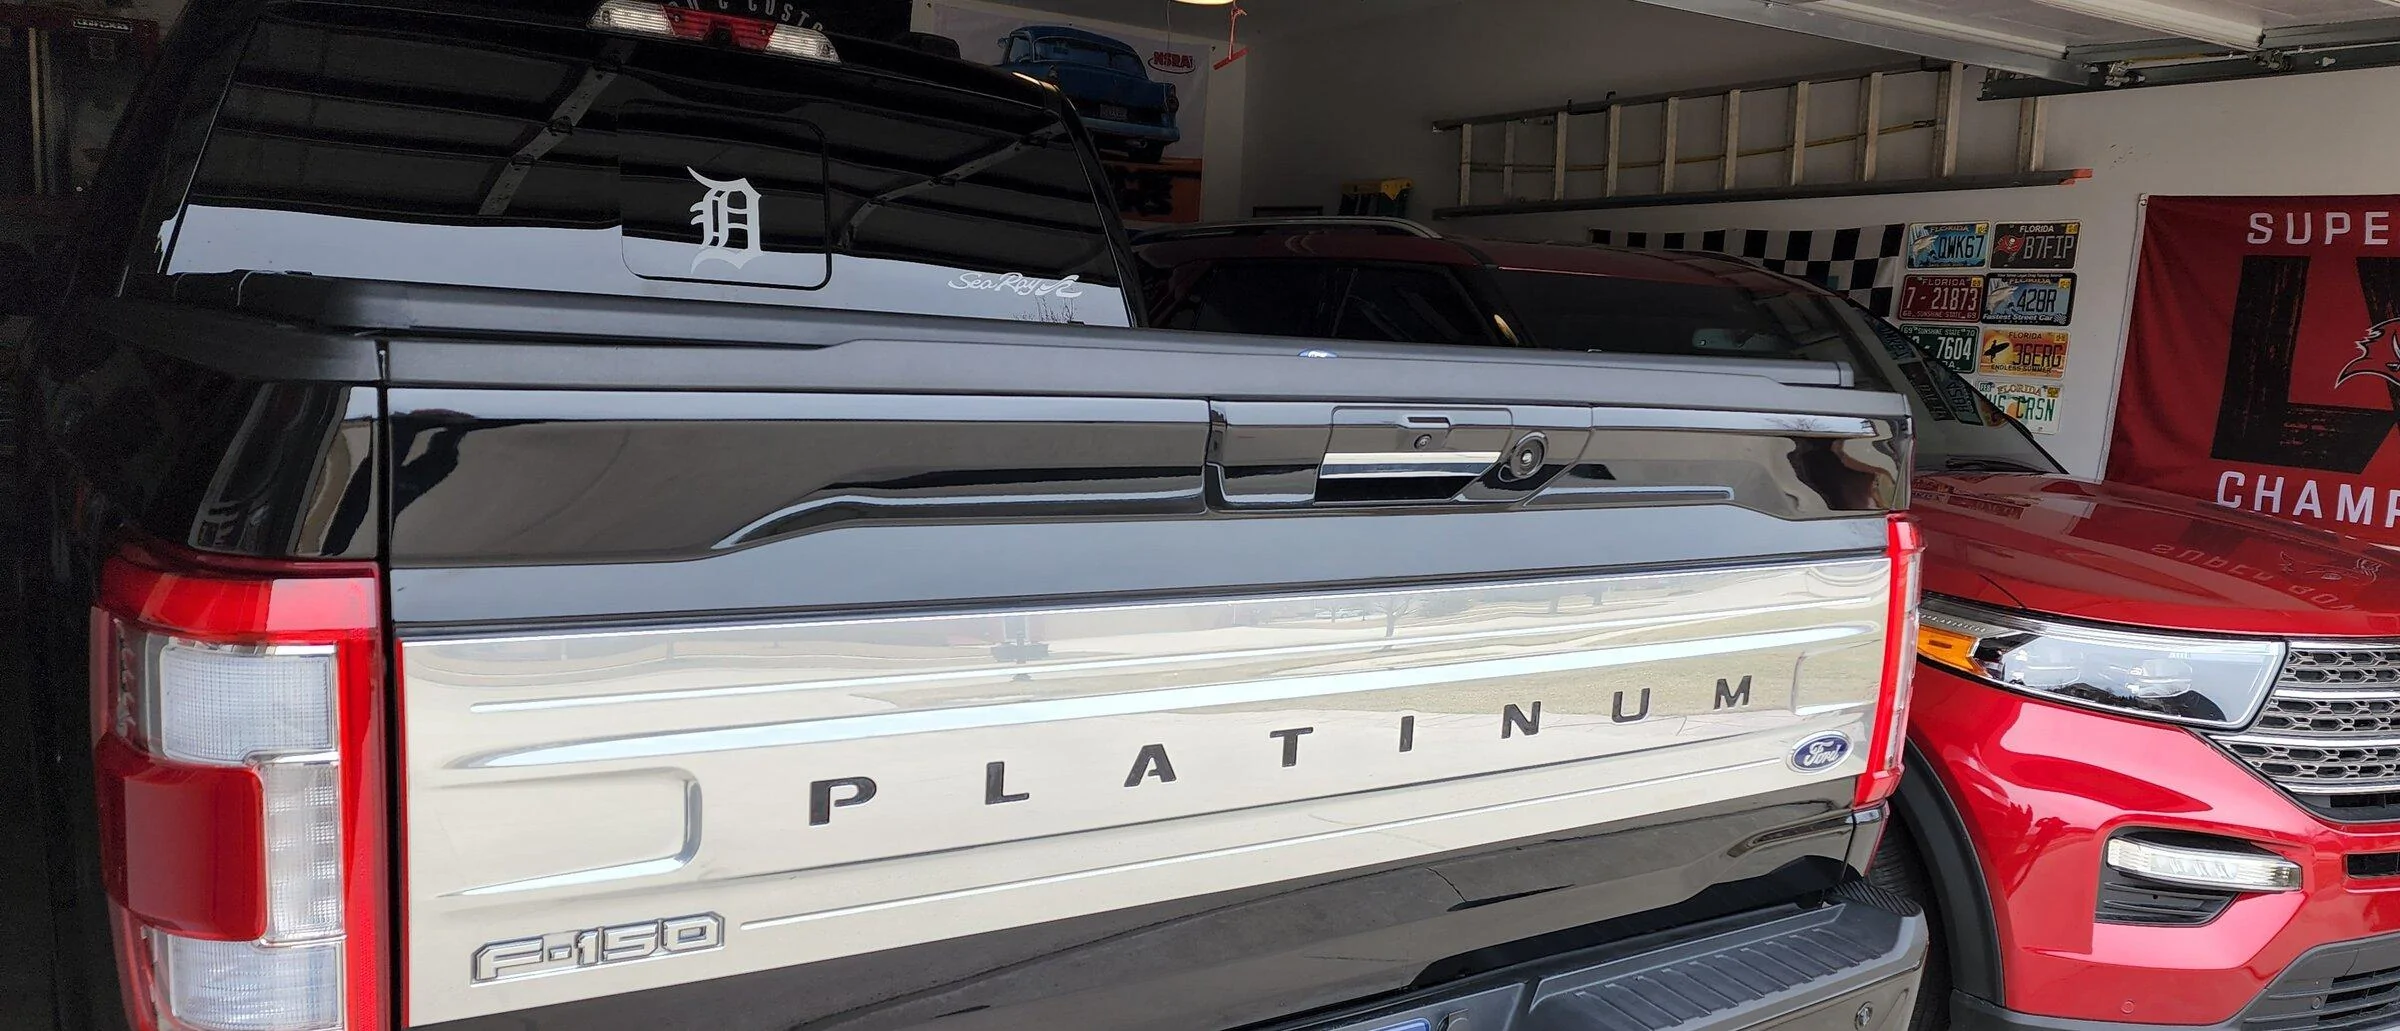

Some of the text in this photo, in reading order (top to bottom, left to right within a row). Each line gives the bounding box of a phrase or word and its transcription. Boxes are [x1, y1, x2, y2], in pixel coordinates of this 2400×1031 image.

[1929, 224, 1970, 233] FLORIDA
[2019, 224, 2055, 234] FLORIDA
[2246, 211, 2390, 245] SUPE
[1938, 235, 1984, 259] QWK67
[2022, 235, 2074, 260] B7FIP
[947, 272, 1041, 296] Sea Ray
[1922, 277, 1966, 287] FLORIDA
[1930, 287, 1979, 311] 21873
[2012, 313, 2037, 321] Street
[2008, 331, 2042, 340] FLORIDA
[1936, 336, 1972, 360] 7604
[1991, 364, 2052, 374] ENDLESS SUMMER
[1997, 383, 2042, 397] FLORIDA
[808, 674, 1753, 826] PLATINUM
[1803, 740, 1842, 767] Ford
[470, 910, 726, 985] F-150
